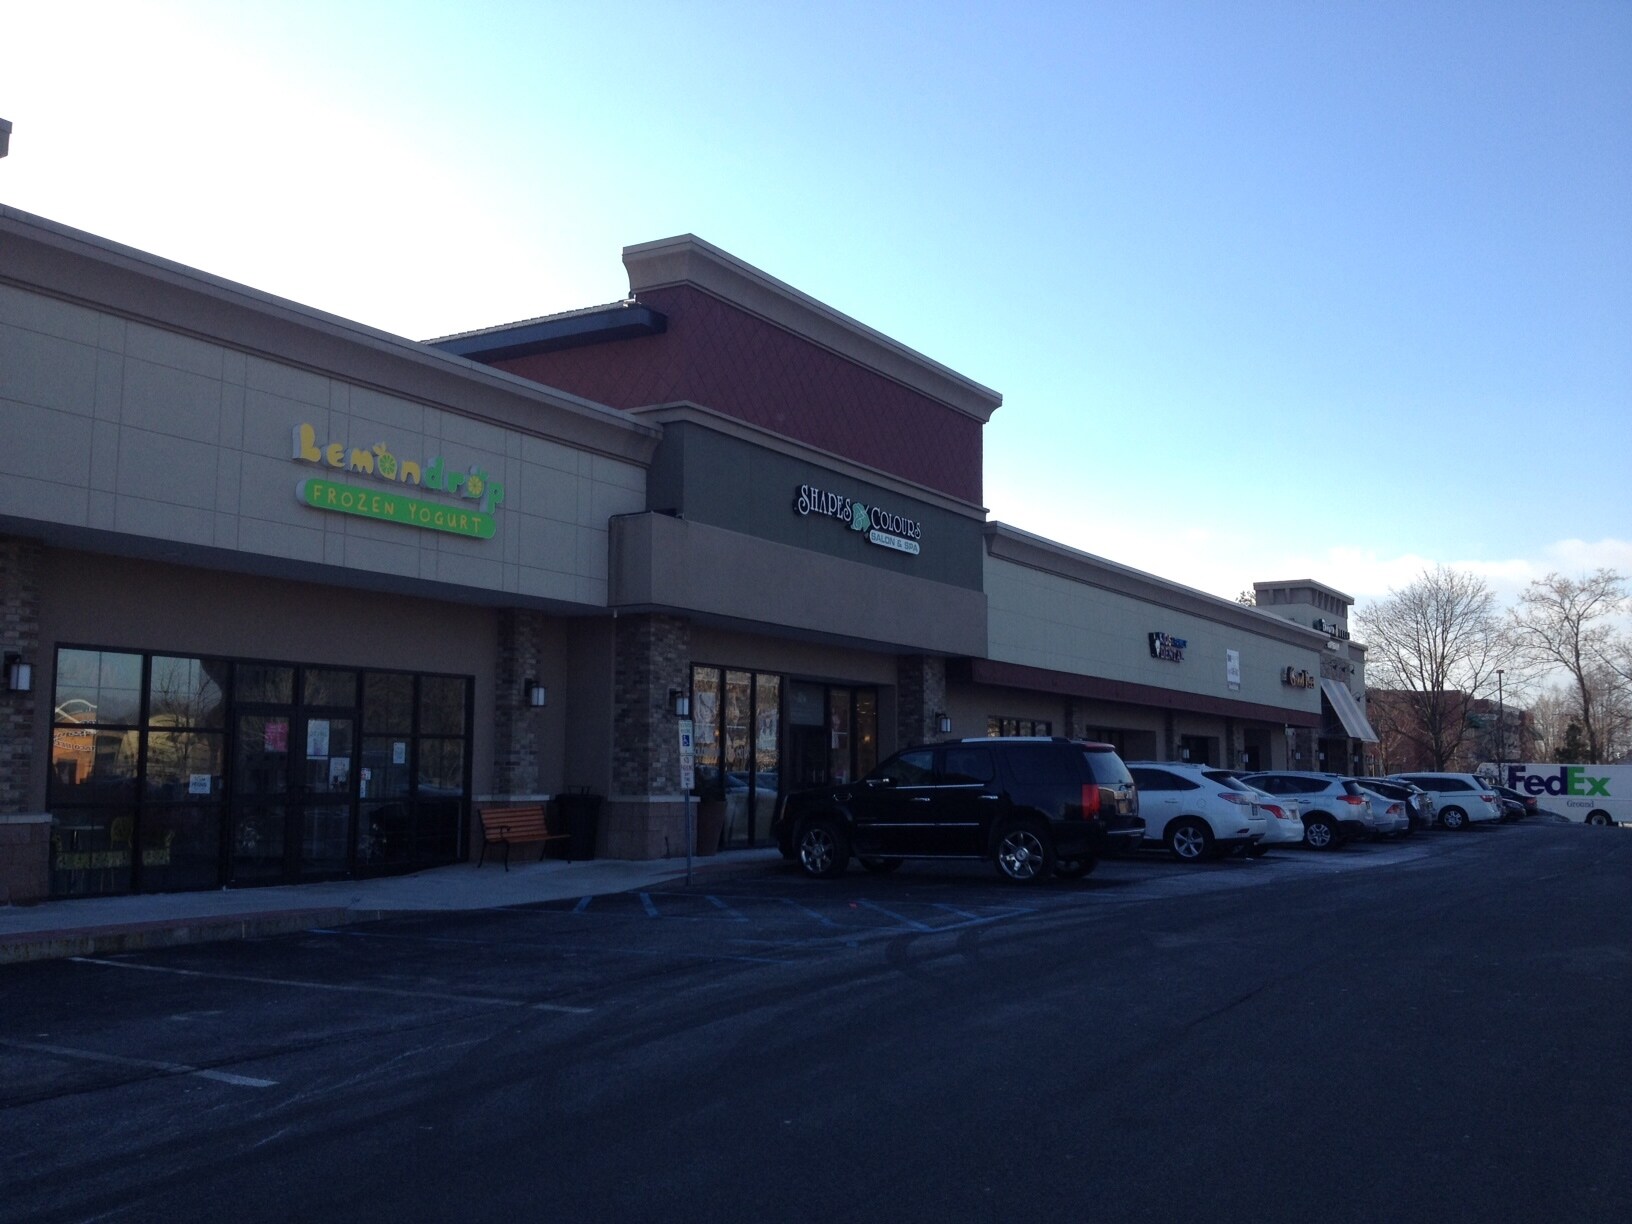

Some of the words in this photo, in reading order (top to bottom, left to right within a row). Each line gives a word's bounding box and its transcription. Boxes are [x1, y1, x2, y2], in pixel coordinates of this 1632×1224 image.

[313, 485, 395, 515] FROZEN
[408, 503, 482, 533] YOGURT
[798, 484, 852, 522] SHAPES
[870, 507, 921, 540] COLOURS
[871, 532, 896, 547] SALON
[903, 541, 919, 553] SPA
[1508, 765, 1611, 797] FedEx
[1566, 800, 1595, 808] Ground
